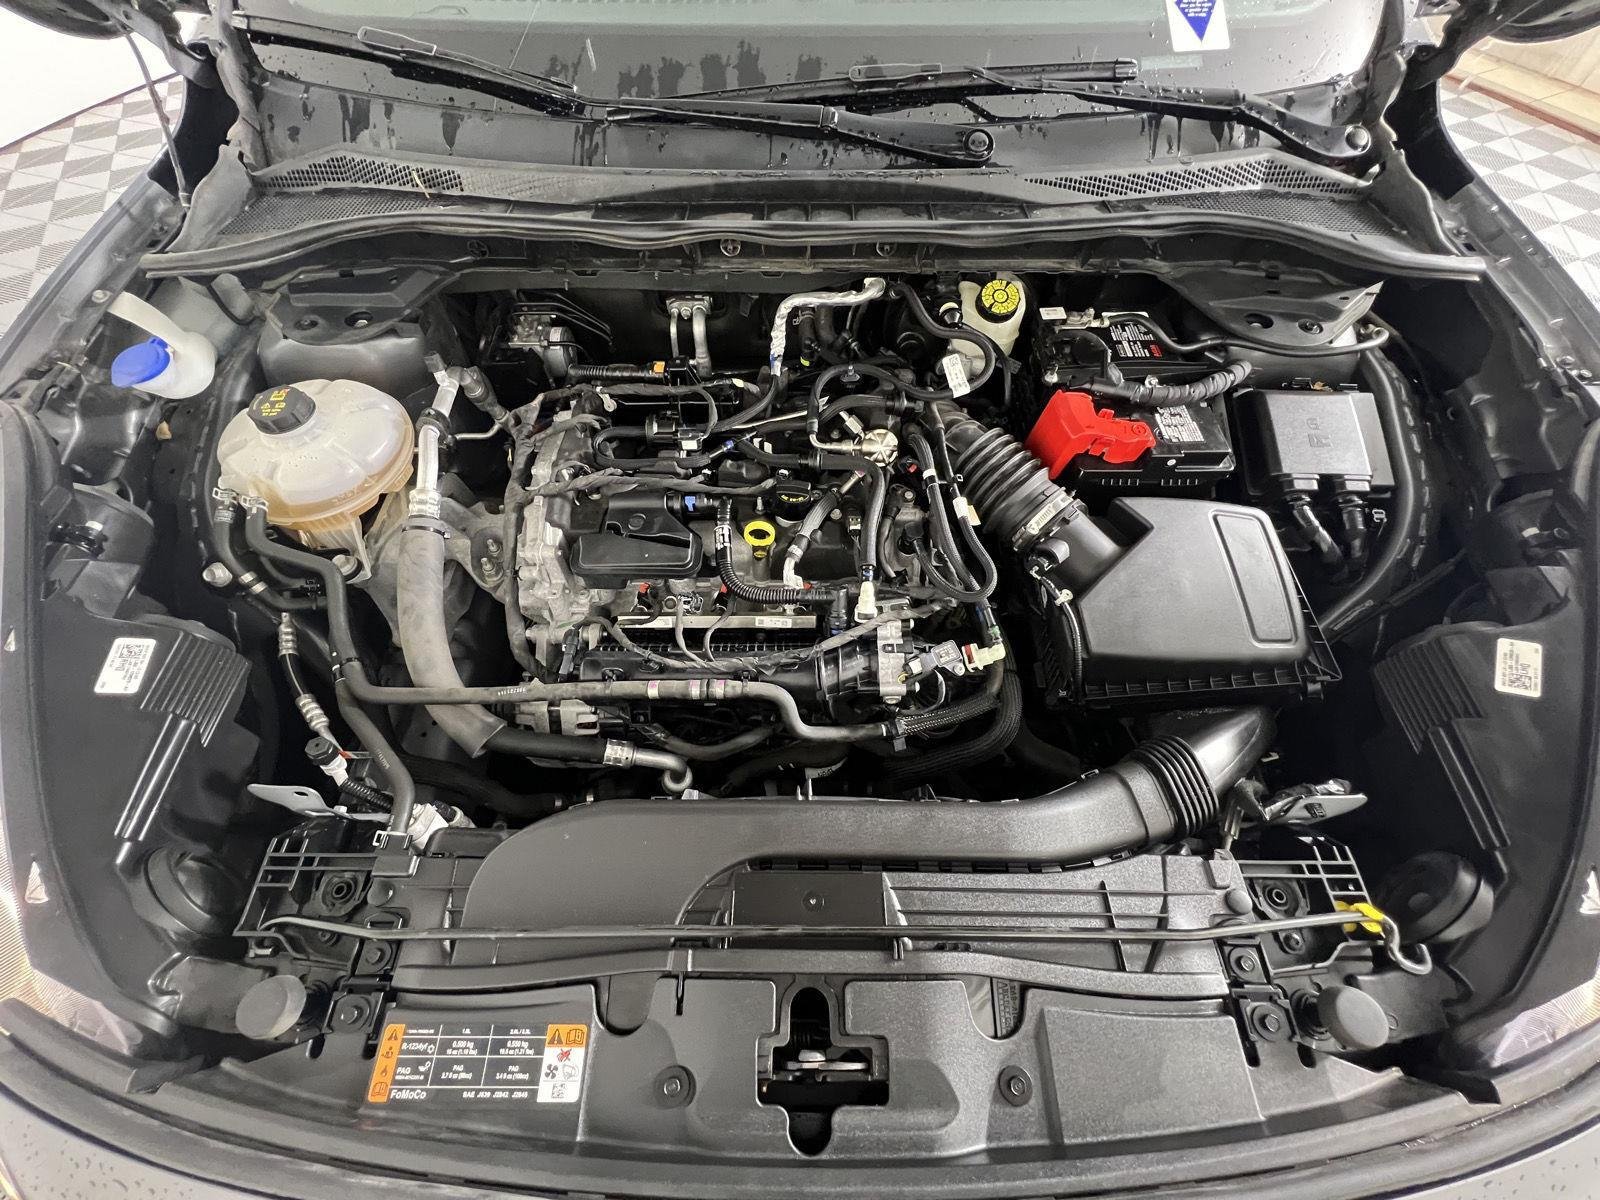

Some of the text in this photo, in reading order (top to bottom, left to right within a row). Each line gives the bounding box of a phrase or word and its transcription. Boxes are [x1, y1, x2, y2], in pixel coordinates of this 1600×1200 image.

[401, 1042, 428, 1051] R-1234yf
[467, 1041, 475, 1049] kg
[521, 1041, 529, 1049] kg
[396, 1066, 411, 1074] PAG
[390, 1089, 427, 1099] FoMoCo
